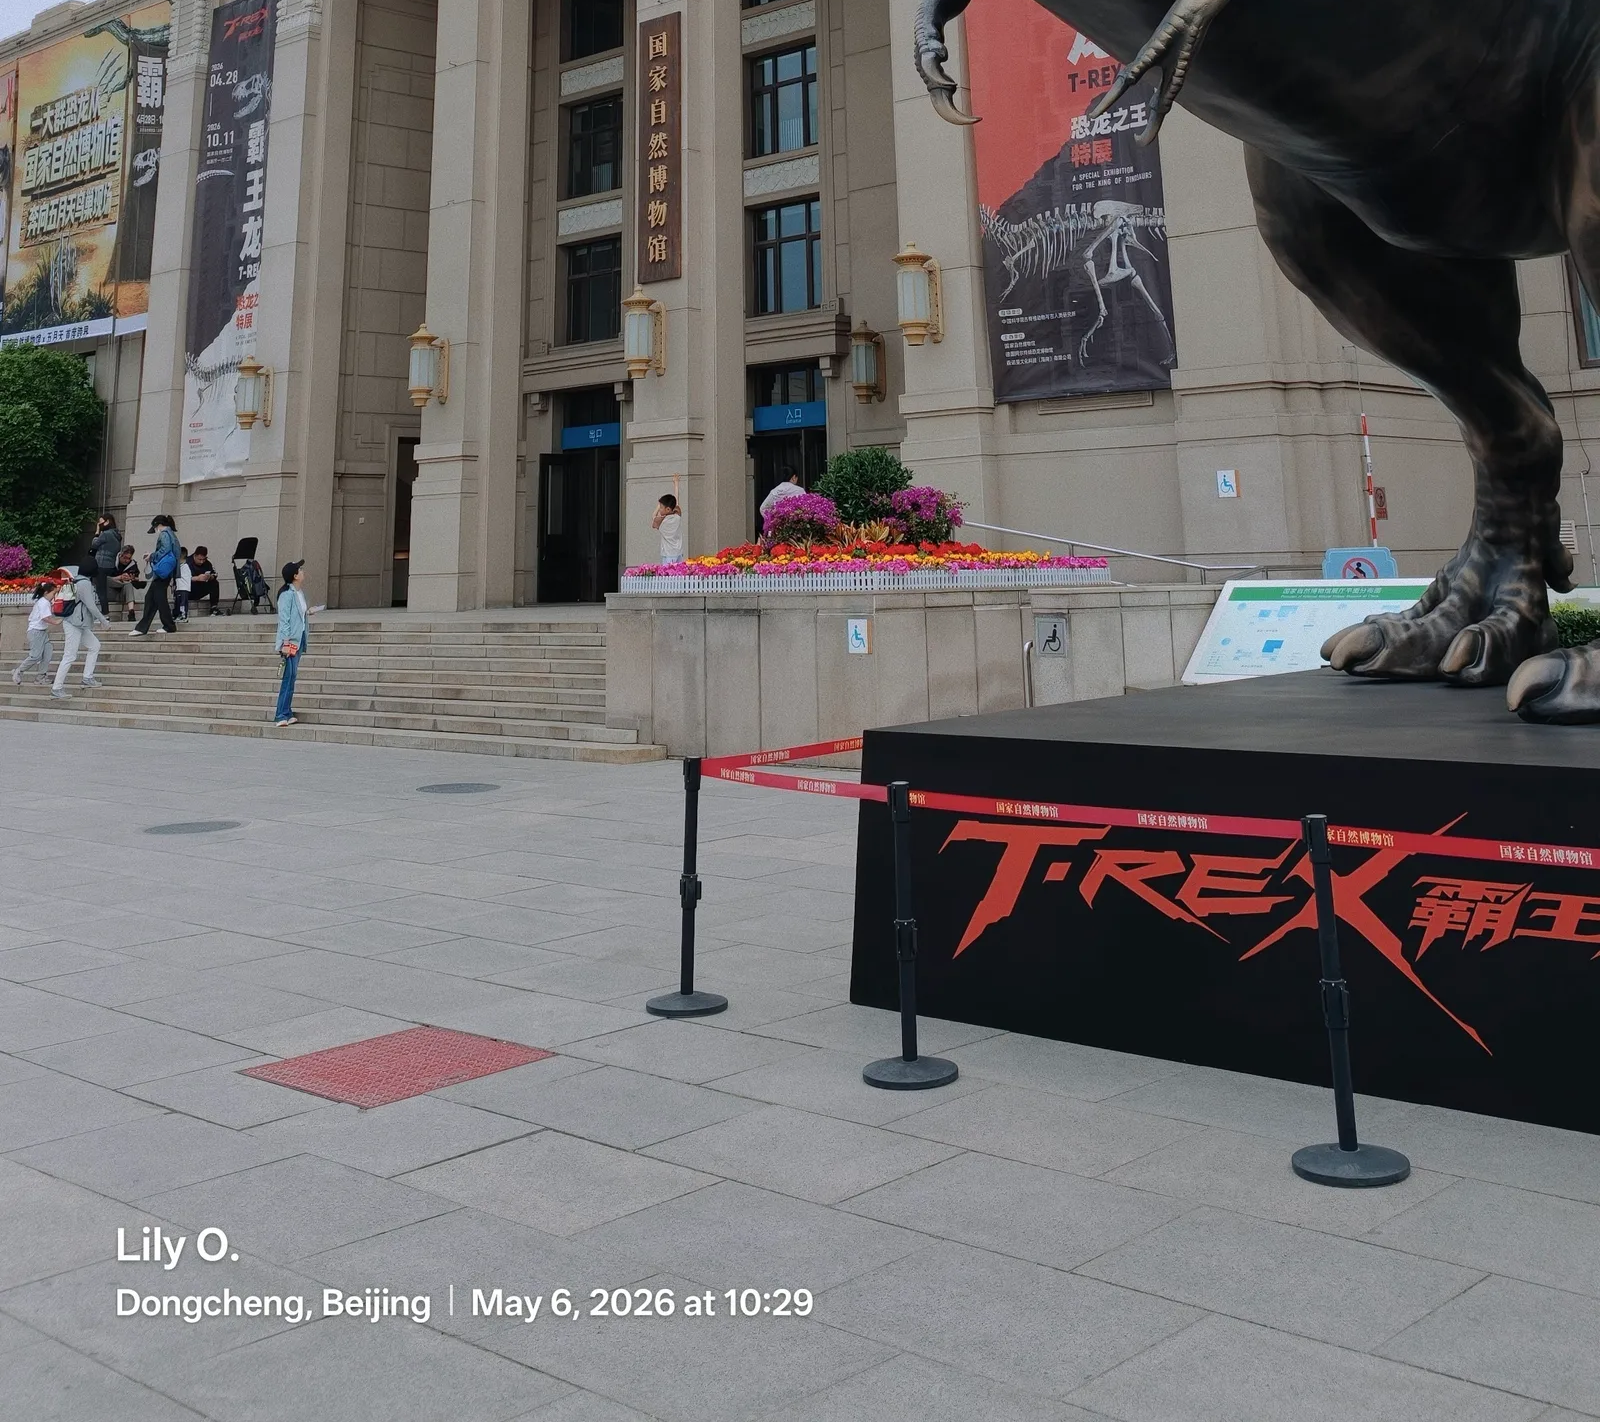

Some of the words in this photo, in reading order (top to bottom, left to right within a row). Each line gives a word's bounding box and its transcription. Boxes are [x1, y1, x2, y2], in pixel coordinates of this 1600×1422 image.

[210, 62, 223, 71] 2026
[137, 55, 163, 107] 霸
[210, 70, 239, 87] 04.28
[31, 87, 101, 138] 一大群恐龙从
[1071, 102, 1147, 139] 恐龙之王
[207, 131, 234, 147] 10.11
[648, 31, 668, 263] 国家自然博物馆
[22, 115, 122, 190] 国家自然博物馆
[1071, 138, 1112, 168] 特展
[1079, 171, 1100, 180] SPECIAL
[1104, 166, 1134, 177] EXHIBITION
[1085, 181, 1095, 189] THE
[1098, 178, 1111, 187] KING
[1126, 171, 1152, 183] DINOSAURS
[240, 119, 265, 262] 霸王龙
[27, 183, 112, 237] 奔向五月天鸟巢现场
[235, 313, 253, 330] 特展
[786, 409, 801, 418] 入口
[750, 750, 790, 764] 国家自然博物馆
[720, 768, 755, 782] 国家自然博物馆
[797, 780, 836, 793] 国家自然博物馆
[909, 792, 925, 805] 物馆
[995, 802, 1058, 818] 国家自然博物馆
[1138, 813, 1207, 829] 国家自然博物馆
[1327, 828, 1394, 847] 家自然博物馆
[1500, 845, 1593, 865] 国家自然博物馆
[1407, 875, 1600, 963] 霸王
